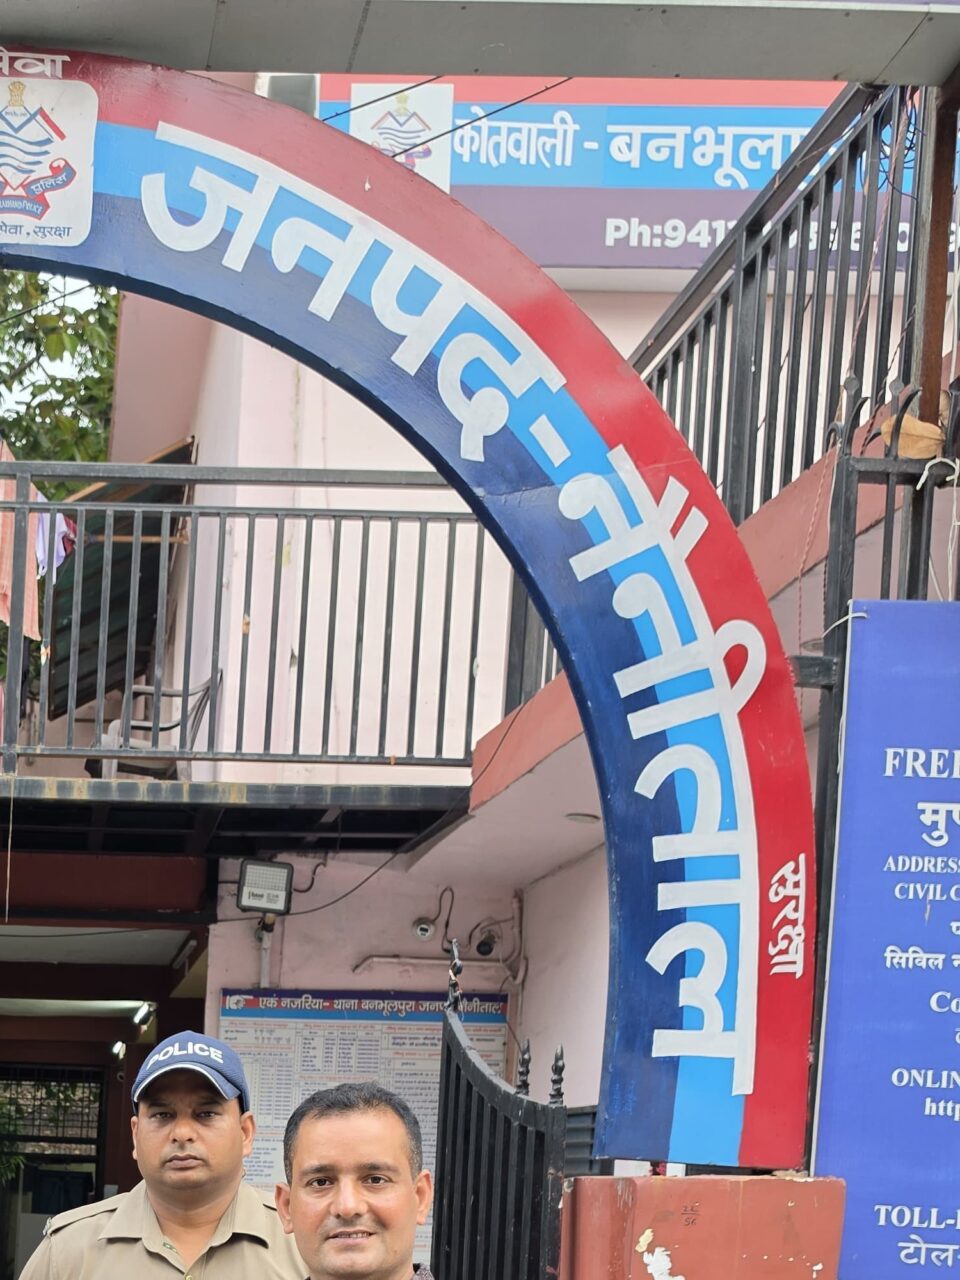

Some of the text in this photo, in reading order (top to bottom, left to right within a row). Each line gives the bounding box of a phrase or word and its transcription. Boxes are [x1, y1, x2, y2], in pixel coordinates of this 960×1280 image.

[453, 106, 580, 169] कोतवाली
[32, 224, 72, 239] सुरक्षा
[894, 882, 947, 901] CIVIL
[769, 853, 806, 979] सुरक्षा
[883, 945, 946, 970] सिविल
[146, 1042, 224, 1070] POLICE
[874, 1204, 960, 1230] TOLL-
